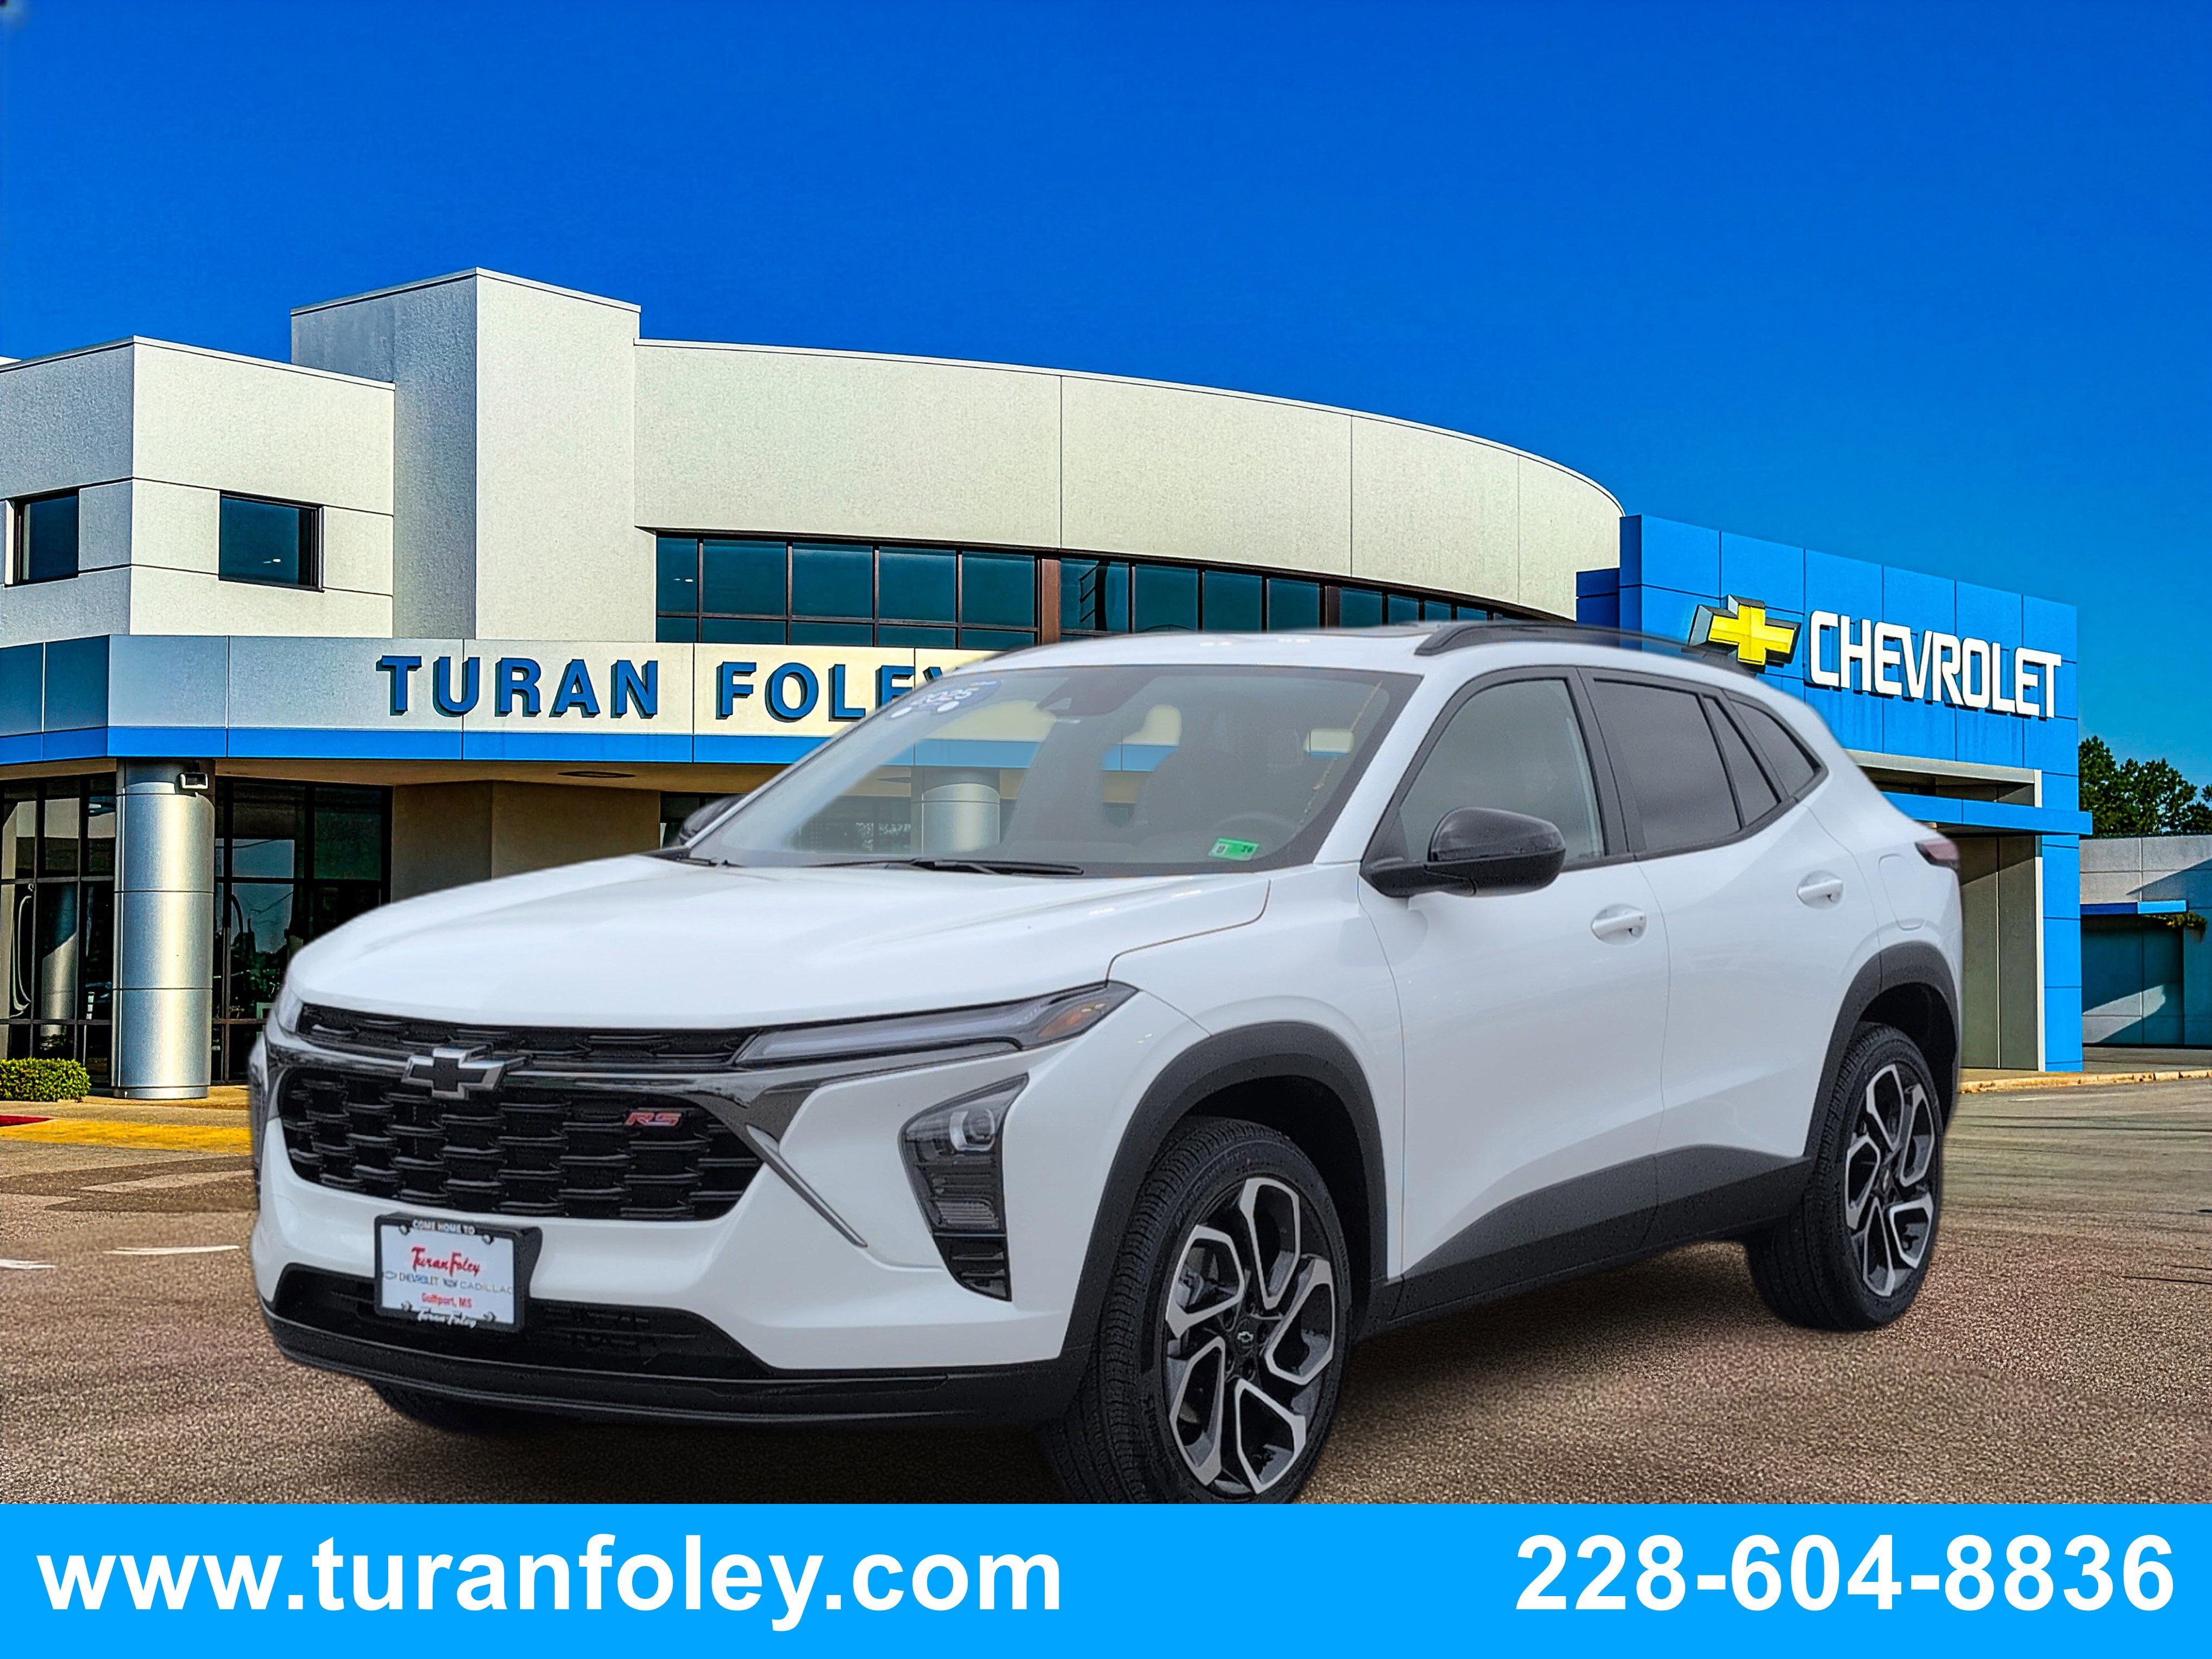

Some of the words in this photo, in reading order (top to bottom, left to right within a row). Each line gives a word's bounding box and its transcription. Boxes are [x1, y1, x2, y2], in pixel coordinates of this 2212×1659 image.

[1810, 610, 2062, 719] CHEVROLET
[376, 655, 659, 718] TURAN
[624, 1111, 681, 1127] RS
[464, 1225, 476, 1236] TO
